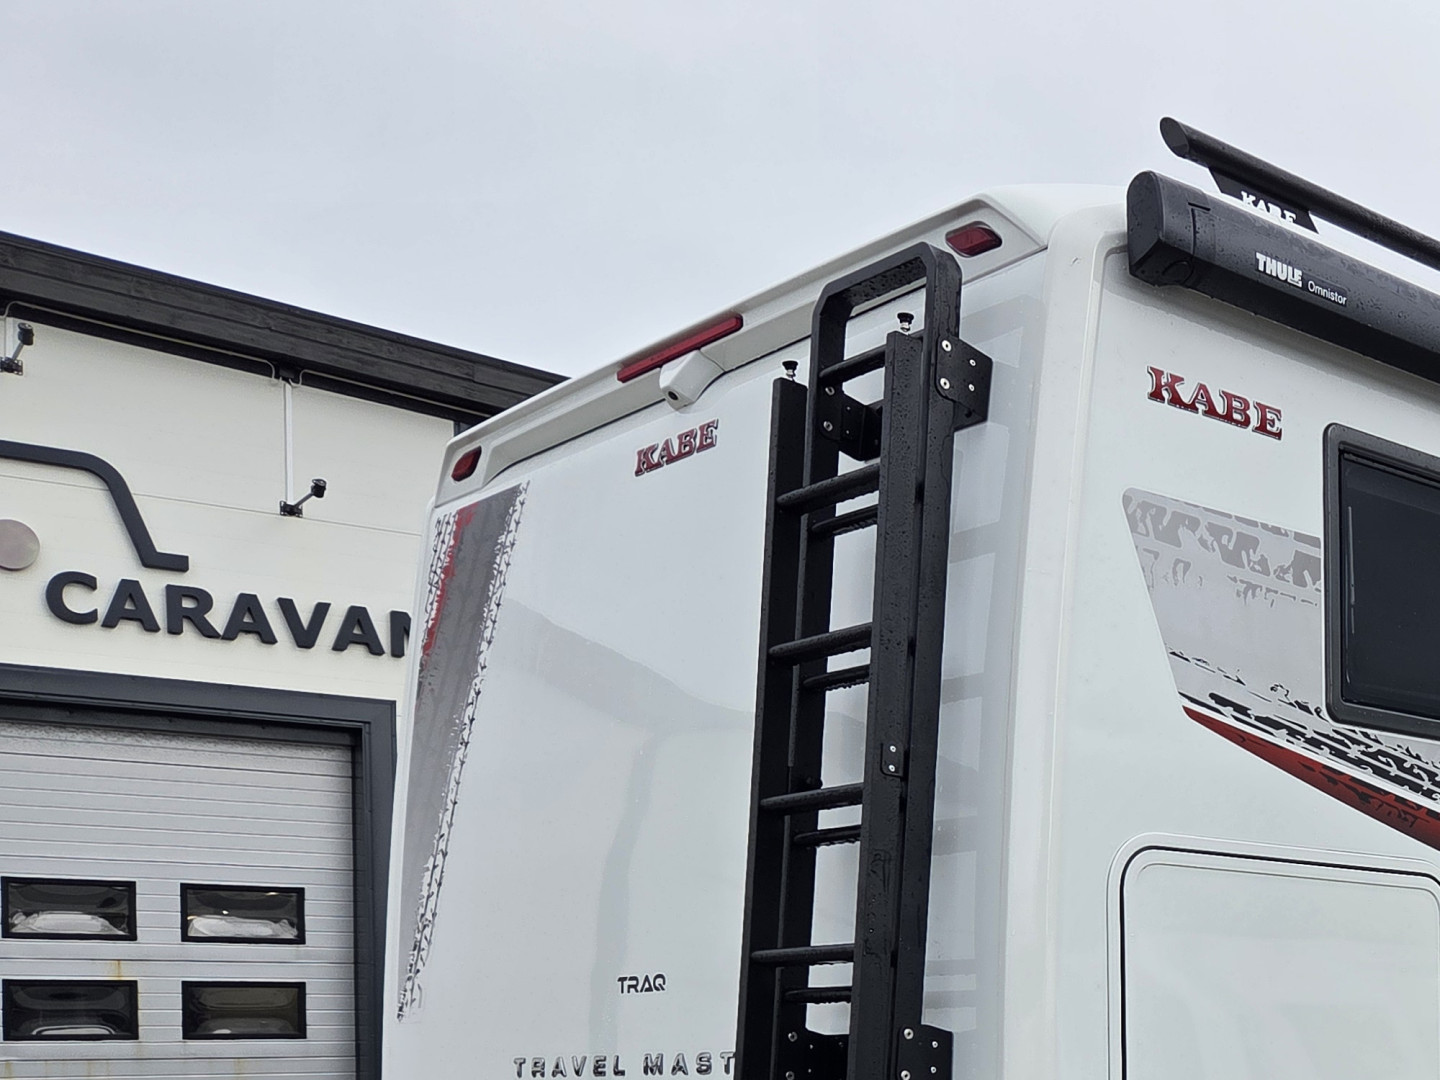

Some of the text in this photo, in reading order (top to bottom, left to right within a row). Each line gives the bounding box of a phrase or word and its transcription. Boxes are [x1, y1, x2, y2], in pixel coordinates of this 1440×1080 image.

[1256, 252, 1347, 305] THULE Omnistor
[1147, 365, 1282, 441] KABE
[634, 418, 719, 477] KABE
[617, 973, 667, 994] TRAQ
[513, 1054, 626, 1079] TRAVEL
